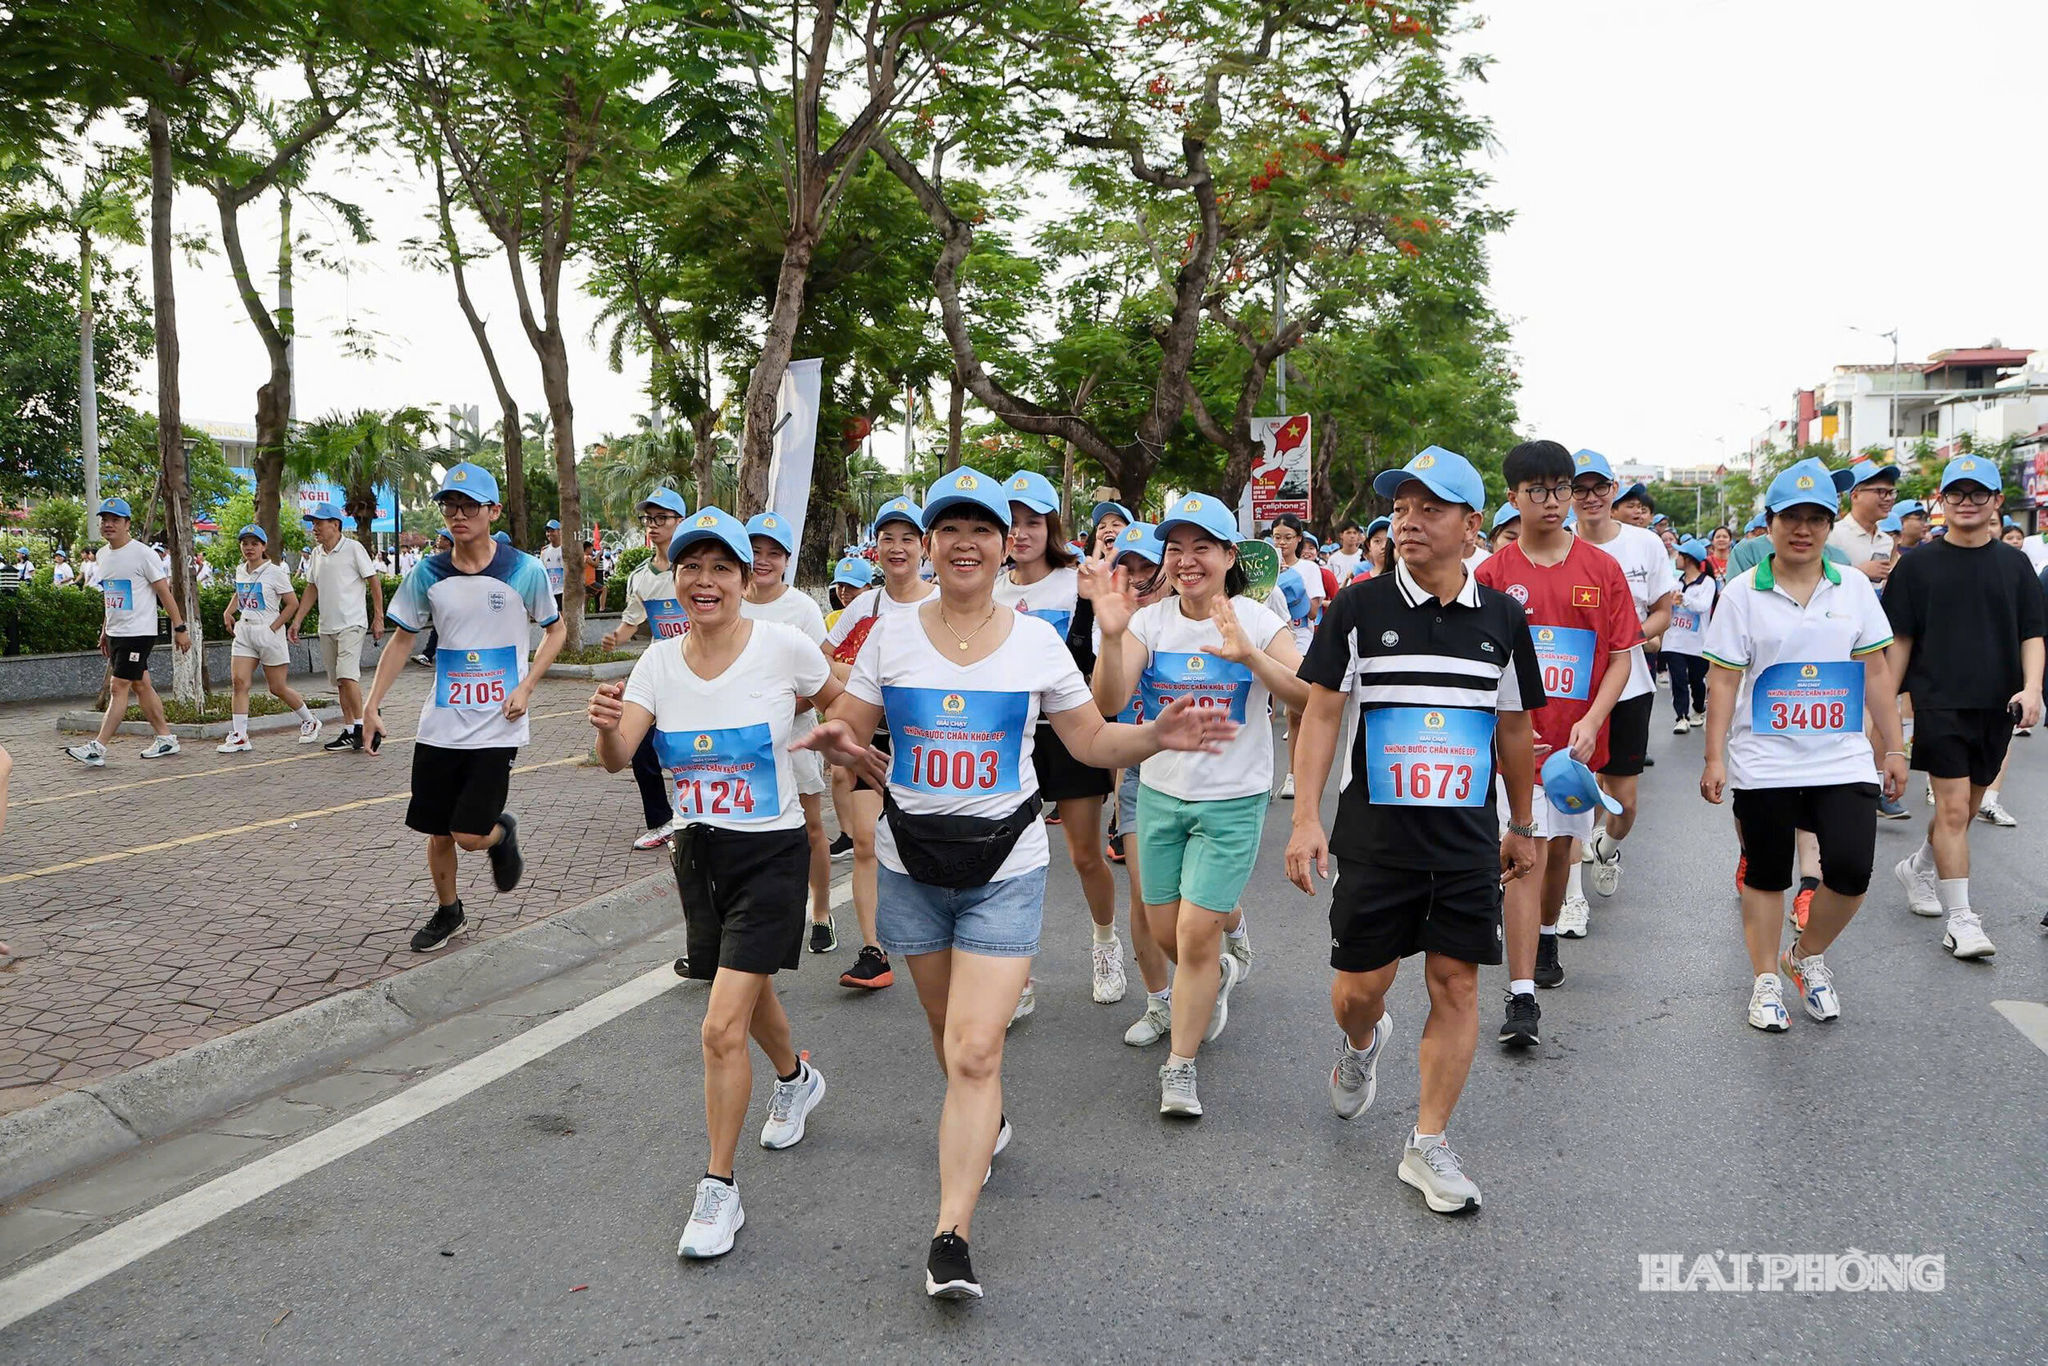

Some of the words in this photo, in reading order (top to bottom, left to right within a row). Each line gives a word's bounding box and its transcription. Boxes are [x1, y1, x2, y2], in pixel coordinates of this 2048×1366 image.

[448, 680, 506, 705] 2105
[1771, 702, 1845, 730] 3408
[912, 745, 999, 790] 1003
[1389, 762, 1472, 800] 1673
[675, 777, 755, 814] 2124
